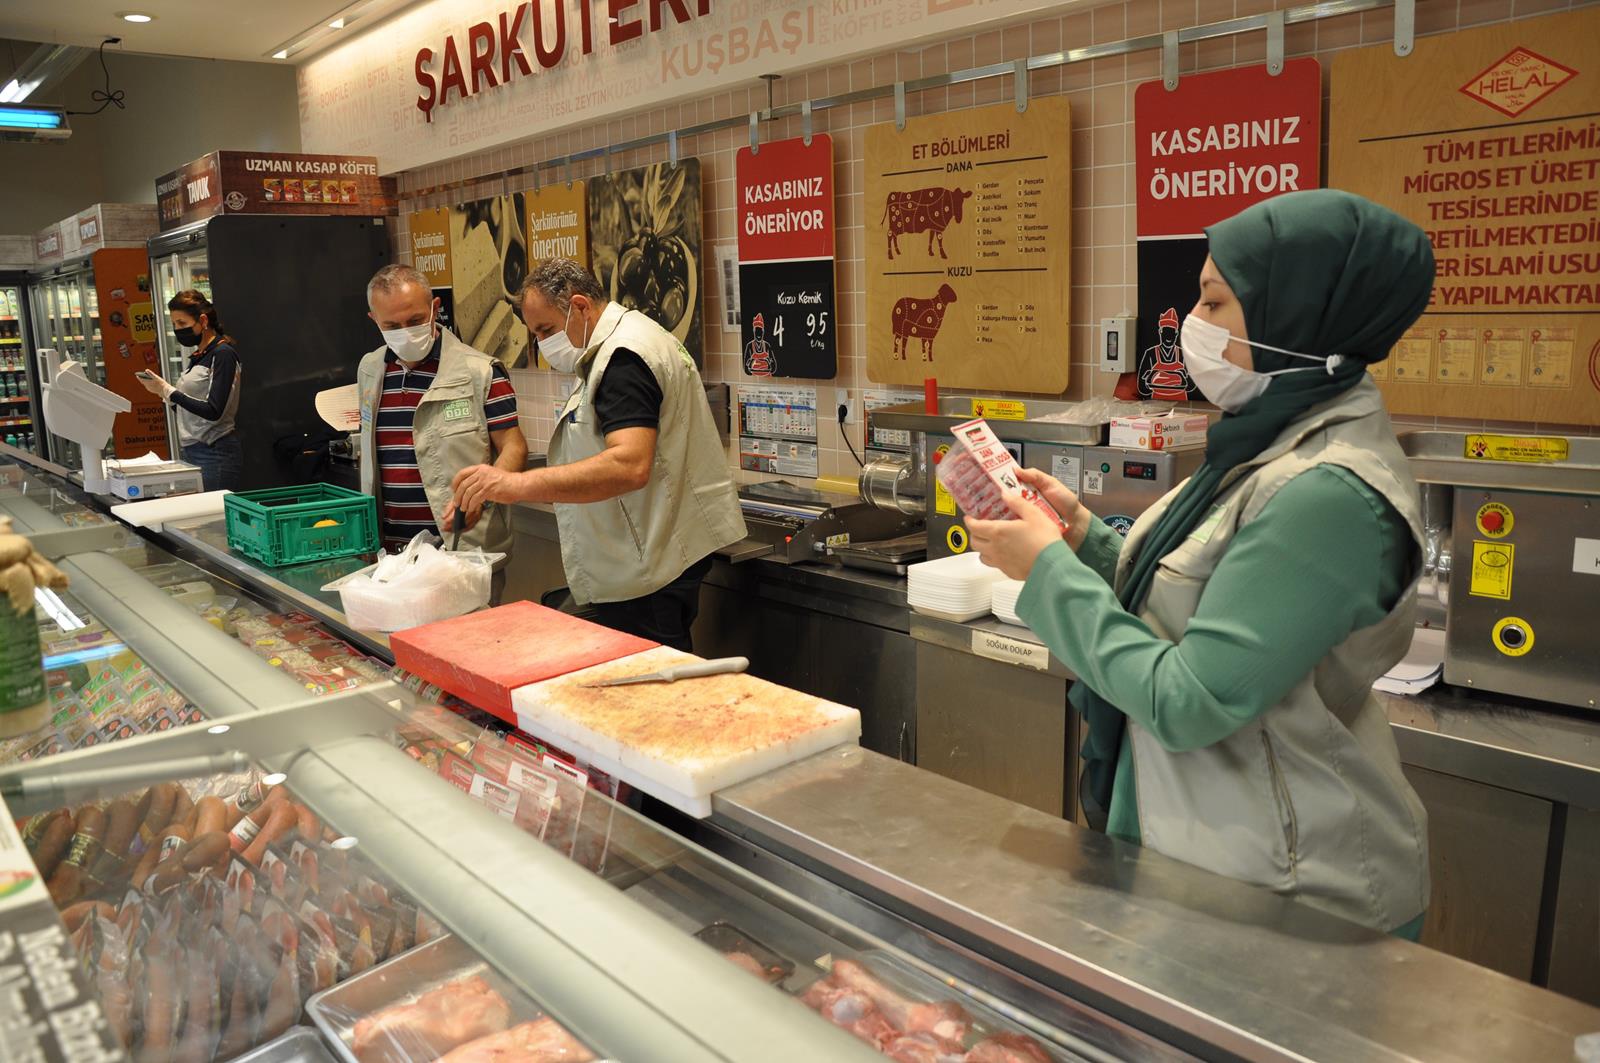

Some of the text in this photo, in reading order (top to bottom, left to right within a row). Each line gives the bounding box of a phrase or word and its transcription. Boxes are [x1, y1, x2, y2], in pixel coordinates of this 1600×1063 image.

[661, 6, 815, 84] KUŞBAŞI
[1480, 72, 1557, 95] HELAL
[912, 129, 1010, 160] ET BÖLÜMLERİ
[1151, 116, 1300, 157] KASABINIZ
[1423, 139, 1475, 164] TÜM
[245, 159, 377, 176] UZMAN KASAP KÖFTE
[946, 161, 973, 173] DANA
[1404, 169, 1491, 194] MİGROS
[1496, 166, 1527, 188] ET
[187, 176, 210, 204] TAVUK
[745, 177, 823, 204] KASABINIZ
[1150, 161, 1299, 200] ÖNERİYOR
[1427, 190, 1599, 221] TESİSLERİNDE
[531, 210, 578, 233] Şarkütörünüz
[745, 208, 824, 235] ÖNERİYOR
[1424, 217, 1600, 250] RETİLMEKTEDİ
[413, 231, 445, 251] Şarkütörünüz
[532, 232, 579, 261] öneriyor
[415, 250, 446, 276] öneriyor
[947, 266, 973, 277] KUZU
[1464, 251, 1544, 277] İSLAMİ
[777, 291, 822, 305] Kuzu Kemik
[773, 311, 828, 347] 4 95
[1479, 503, 1510, 519] EMERGENCY
[986, 639, 1033, 657] SOĞUK DOLAP
